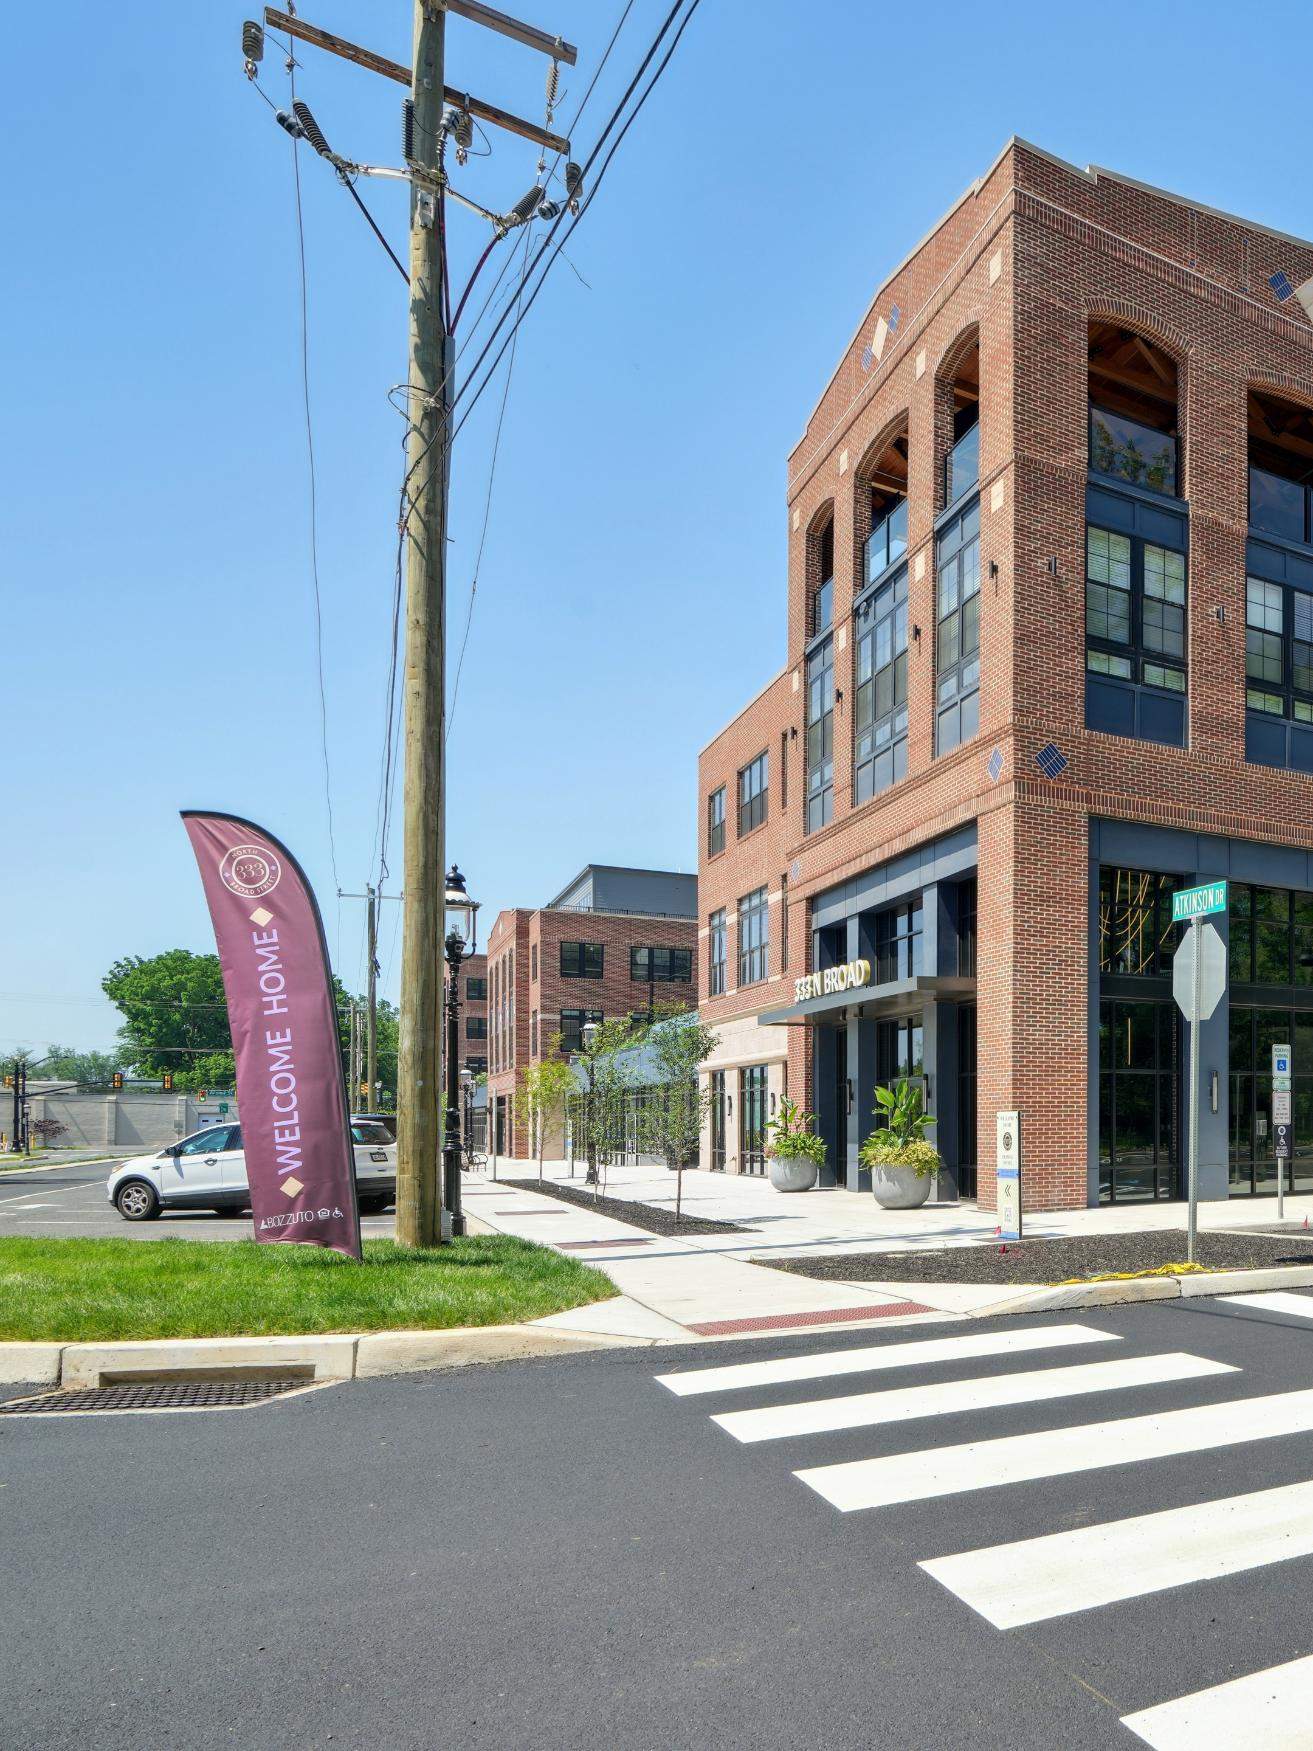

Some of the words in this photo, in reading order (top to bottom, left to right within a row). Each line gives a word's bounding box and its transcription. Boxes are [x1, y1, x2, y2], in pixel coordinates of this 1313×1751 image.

[236, 862, 265, 879] 333
[1174, 888, 1214, 917] ATKINSON
[1215, 888, 1224, 905] DR
[252, 928, 289, 1016] HOME
[794, 975, 814, 1002] 333
[813, 971, 824, 997] N
[824, 959, 870, 995] BROAD
[265, 1028, 303, 1176] WELCOME
[266, 1210, 314, 1229] BOZZUTO
